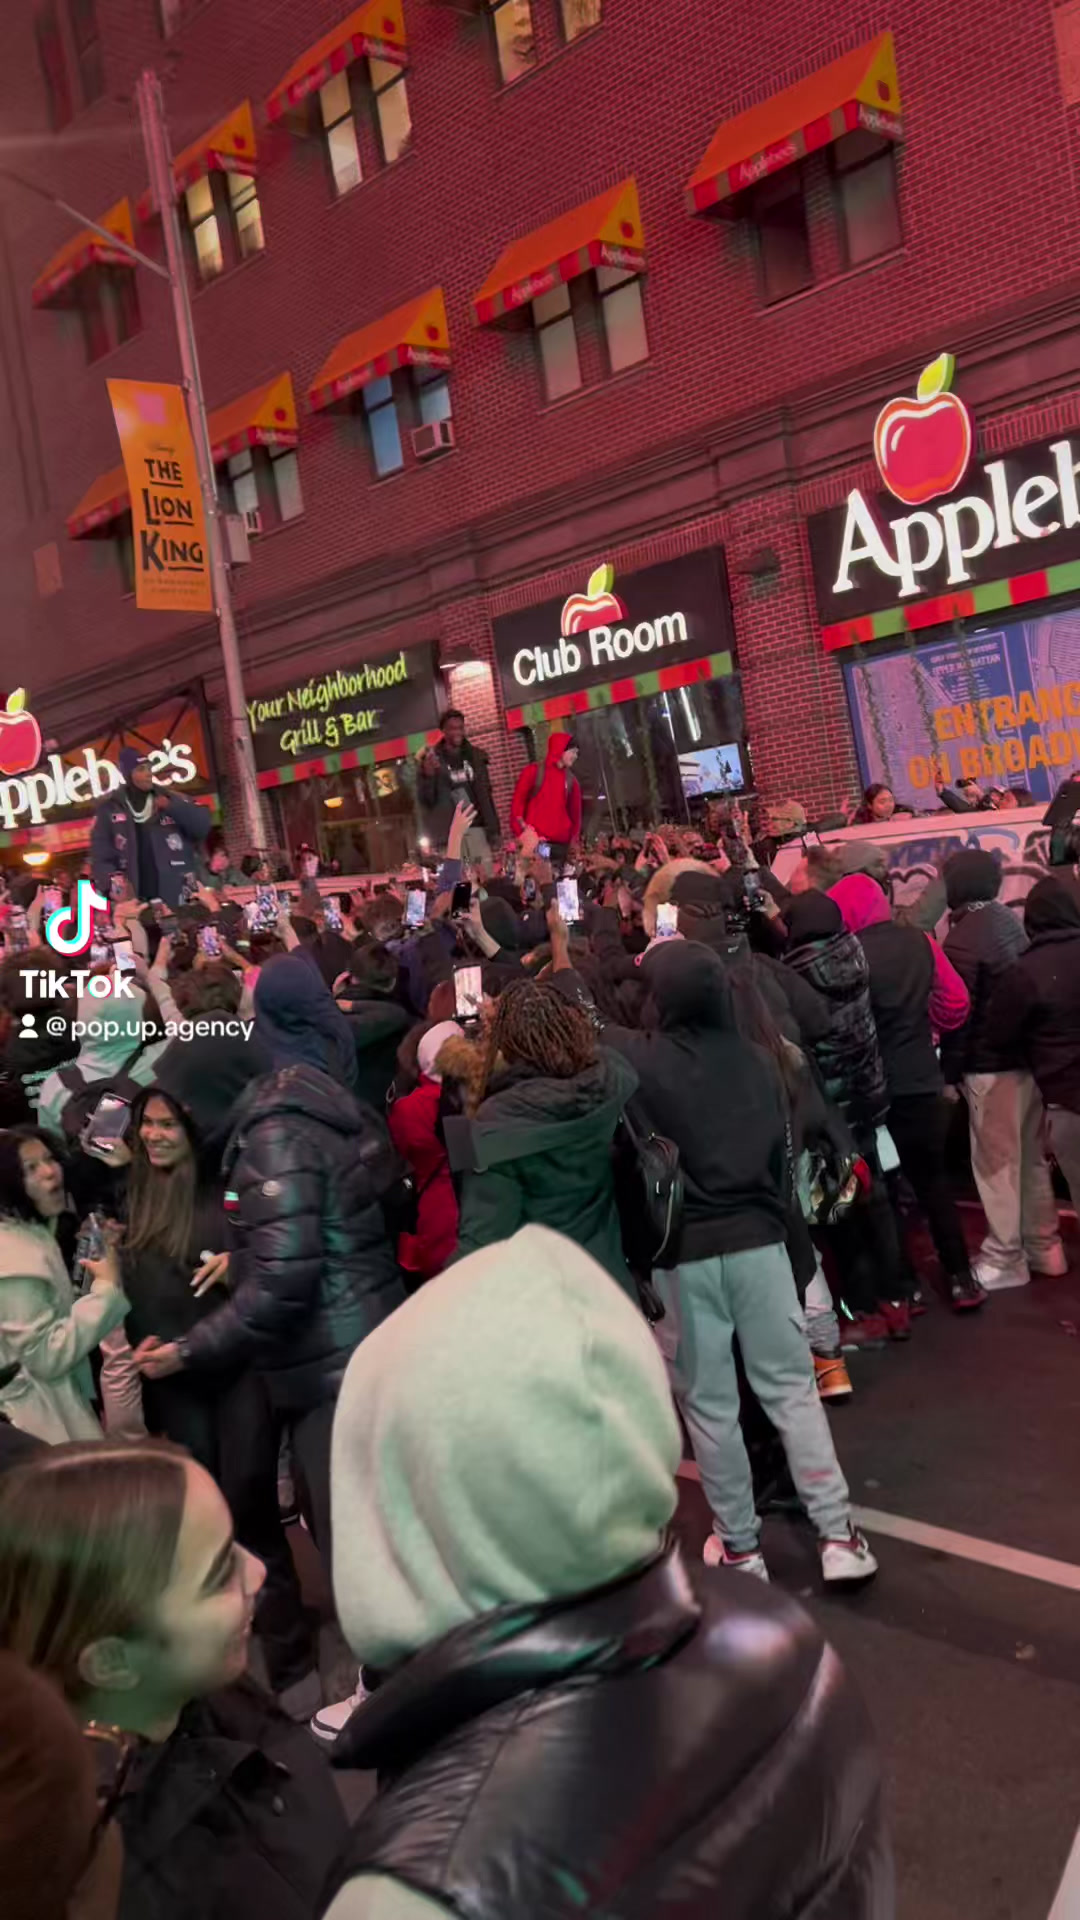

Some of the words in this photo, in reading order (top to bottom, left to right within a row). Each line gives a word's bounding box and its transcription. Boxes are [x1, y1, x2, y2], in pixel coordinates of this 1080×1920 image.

[144, 459, 183, 482] THE
[142, 488, 193, 525] LION
[140, 530, 203, 572] KING
[513, 637, 581, 686] Club
[588, 611, 688, 666] Room
[246, 696, 287, 733] Your
[287, 651, 408, 712] Neighborhood
[280, 717, 321, 756] Grill
[325, 716, 340, 748] &
[340, 709, 377, 736] Bar
